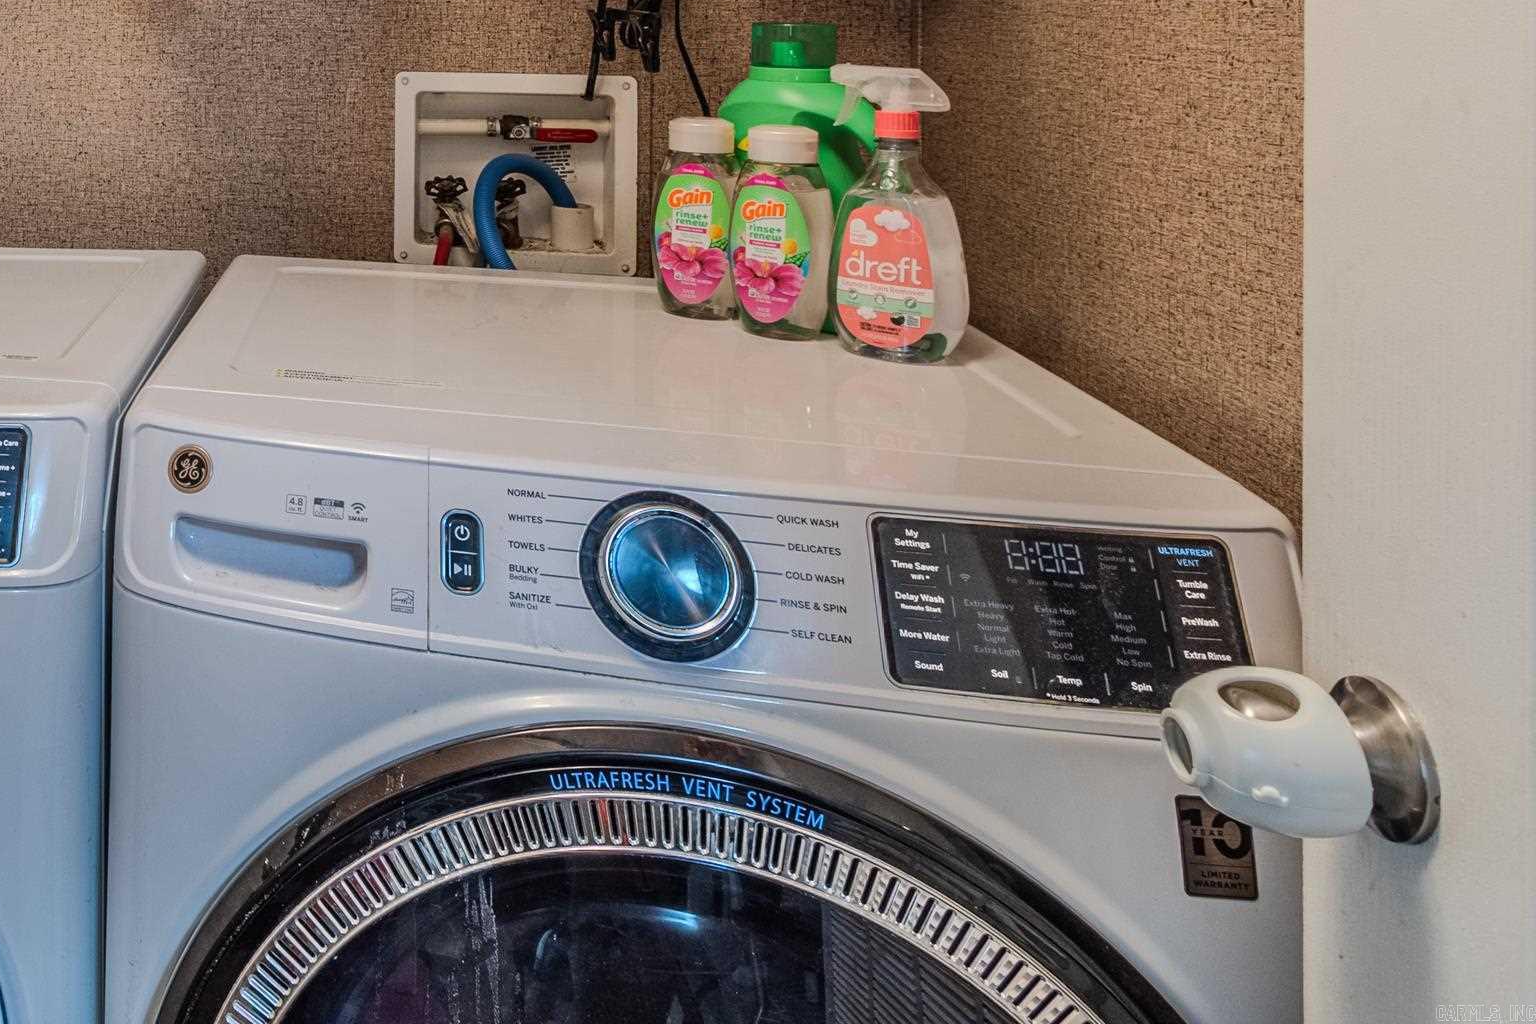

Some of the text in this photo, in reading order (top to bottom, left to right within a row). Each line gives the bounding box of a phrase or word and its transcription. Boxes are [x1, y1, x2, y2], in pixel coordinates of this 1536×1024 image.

[667, 187, 714, 209] Gain
[741, 200, 786, 221] Gain
[845, 250, 923, 285] dreft
[3, 439, 19, 447] Care
[507, 488, 546, 500] NORMAL
[288, 497, 304, 507] 4.8
[348, 515, 368, 523] SMART
[508, 513, 544, 524] WHITES
[776, 514, 840, 529] QUICK WASH
[905, 528, 918, 539] My
[508, 540, 545, 552] TOWELS
[787, 542, 842, 556] DELICATES
[894, 538, 931, 550] Settings
[1157, 546, 1214, 558] ULTRAFRESH
[891, 559, 940, 572] Time Saver
[1176, 558, 1201, 567] VENT
[509, 564, 539, 574] BULKY
[785, 571, 845, 585] COLD WASH
[1175, 579, 1209, 590] Tumble
[509, 591, 552, 604] SANITIZE
[894, 591, 945, 604] Delay Wash
[1184, 590, 1206, 600] Care
[509, 601, 526, 609] With
[780, 598, 848, 614] RINSE & SPIN
[900, 603, 942, 613] Remote Start
[963, 598, 987, 608] Extra
[1181, 616, 1220, 628] PreWash
[976, 623, 1010, 633] Normal
[1046, 629, 1074, 638] Warm
[791, 629, 853, 645] SELF CLEAN
[899, 628, 950, 643] More Water
[1111, 635, 1147, 645] Medium
[1052, 641, 1073, 651] Cold
[1063, 653, 1085, 663] Cold
[1183, 650, 1233, 663] Extra Rinse
[914, 660, 944, 672] Sound
[1131, 658, 1152, 669] Spin
[990, 668, 1009, 679] Soil
[1056, 675, 1084, 687] Temp
[1130, 681, 1154, 693] Spin
[1072, 695, 1101, 705] Seconds
[549, 771, 825, 831] ULTRAFRESH VENT SYSTEM
[1182, 808, 1253, 860] 10
[1191, 828, 1224, 837] YEAR
[1201, 871, 1240, 880] LIMITED
[1194, 880, 1250, 891] WARRANTY
